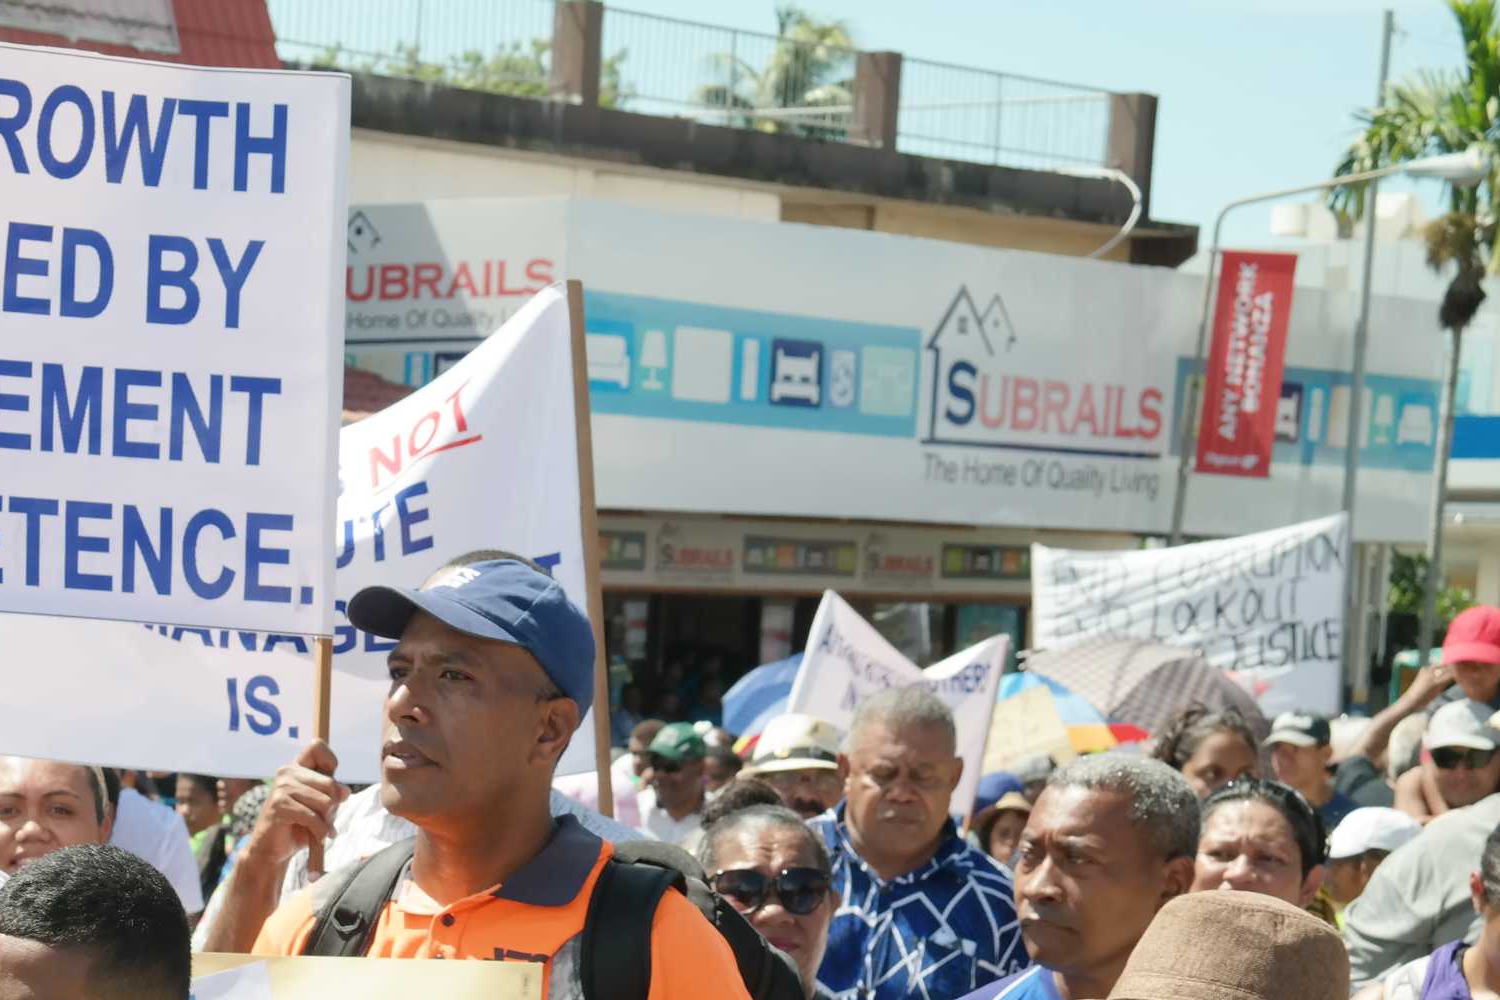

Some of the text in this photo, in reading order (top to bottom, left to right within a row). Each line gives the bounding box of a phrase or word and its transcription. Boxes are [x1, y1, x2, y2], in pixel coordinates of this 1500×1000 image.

[147, 235, 265, 329] BY
[368, 379, 471, 489] NOT
[962, 461, 1016, 488] Home
[227, 674, 299, 739] IS.
